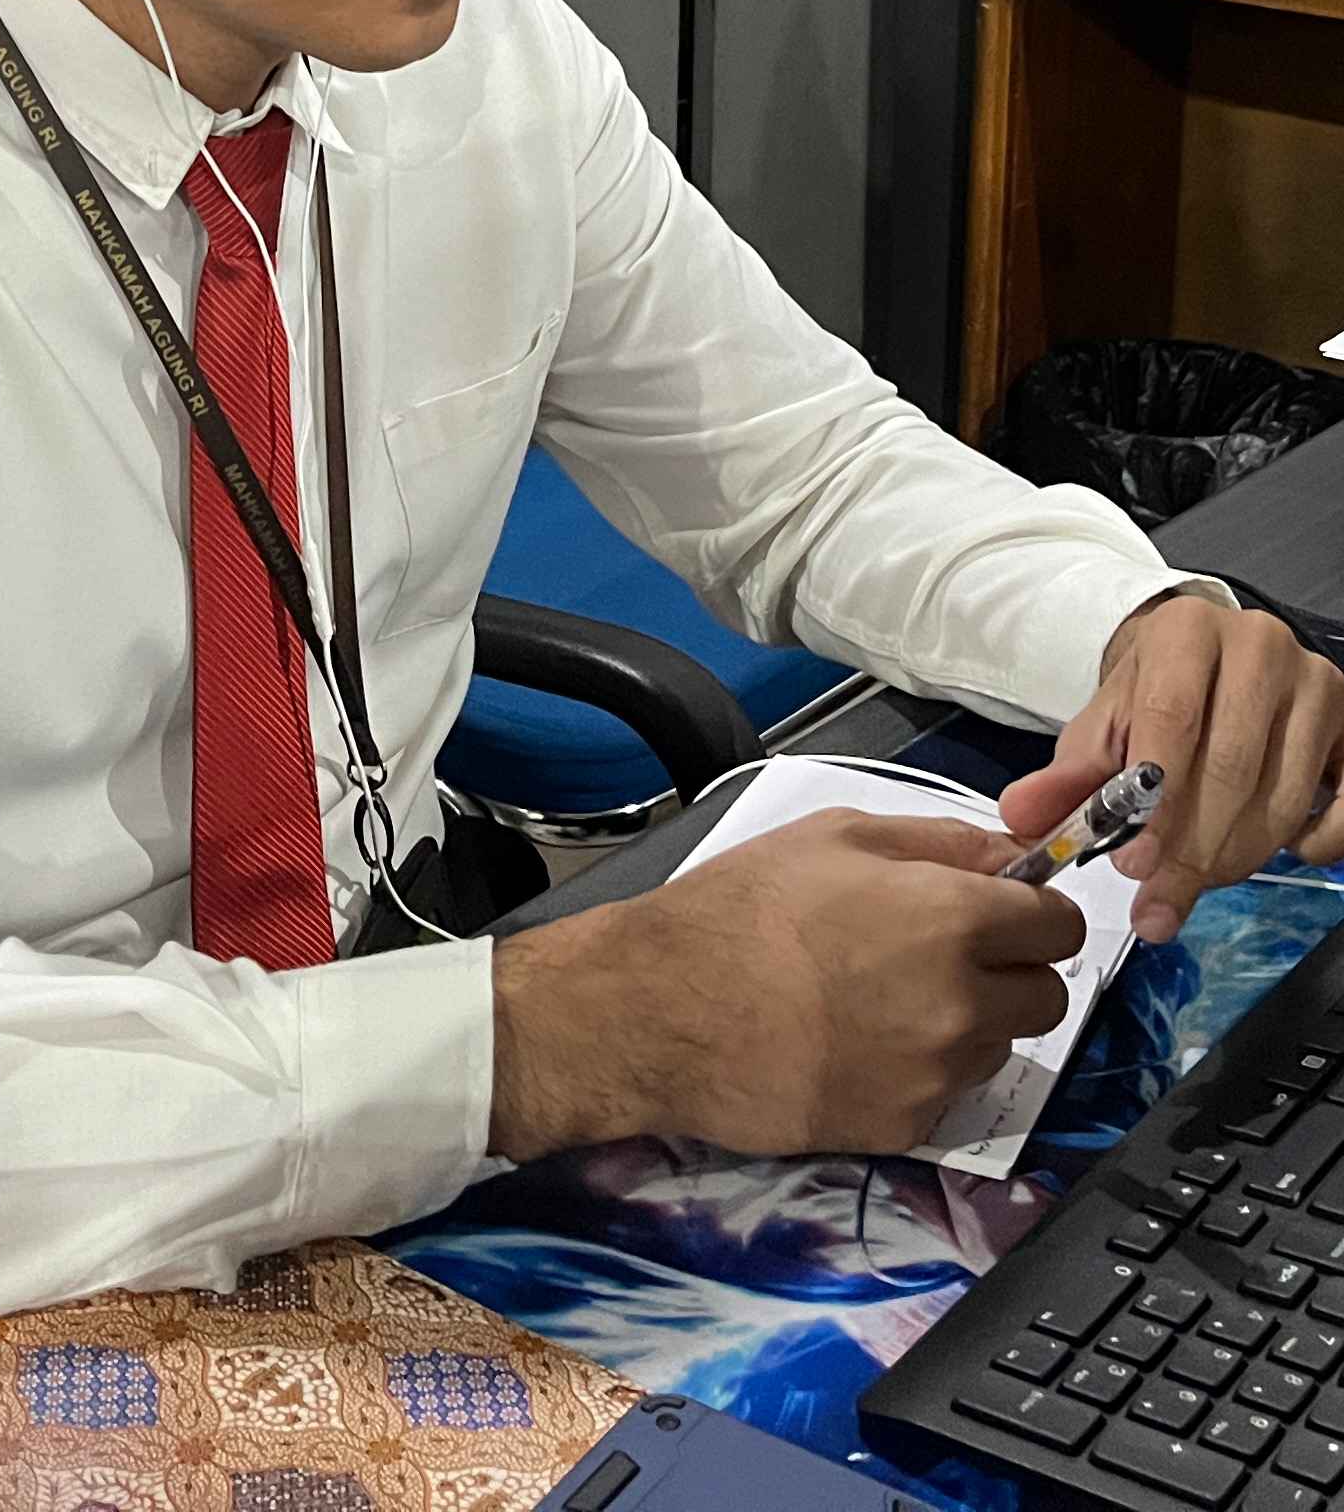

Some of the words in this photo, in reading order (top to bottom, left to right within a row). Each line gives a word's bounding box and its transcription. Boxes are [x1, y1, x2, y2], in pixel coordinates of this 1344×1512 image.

[38, 127, 62, 154] RI
[75, 188, 153, 326] MAHKAMAH
[144, 316, 197, 394] AGUNG
[188, 390, 209, 418] RI
